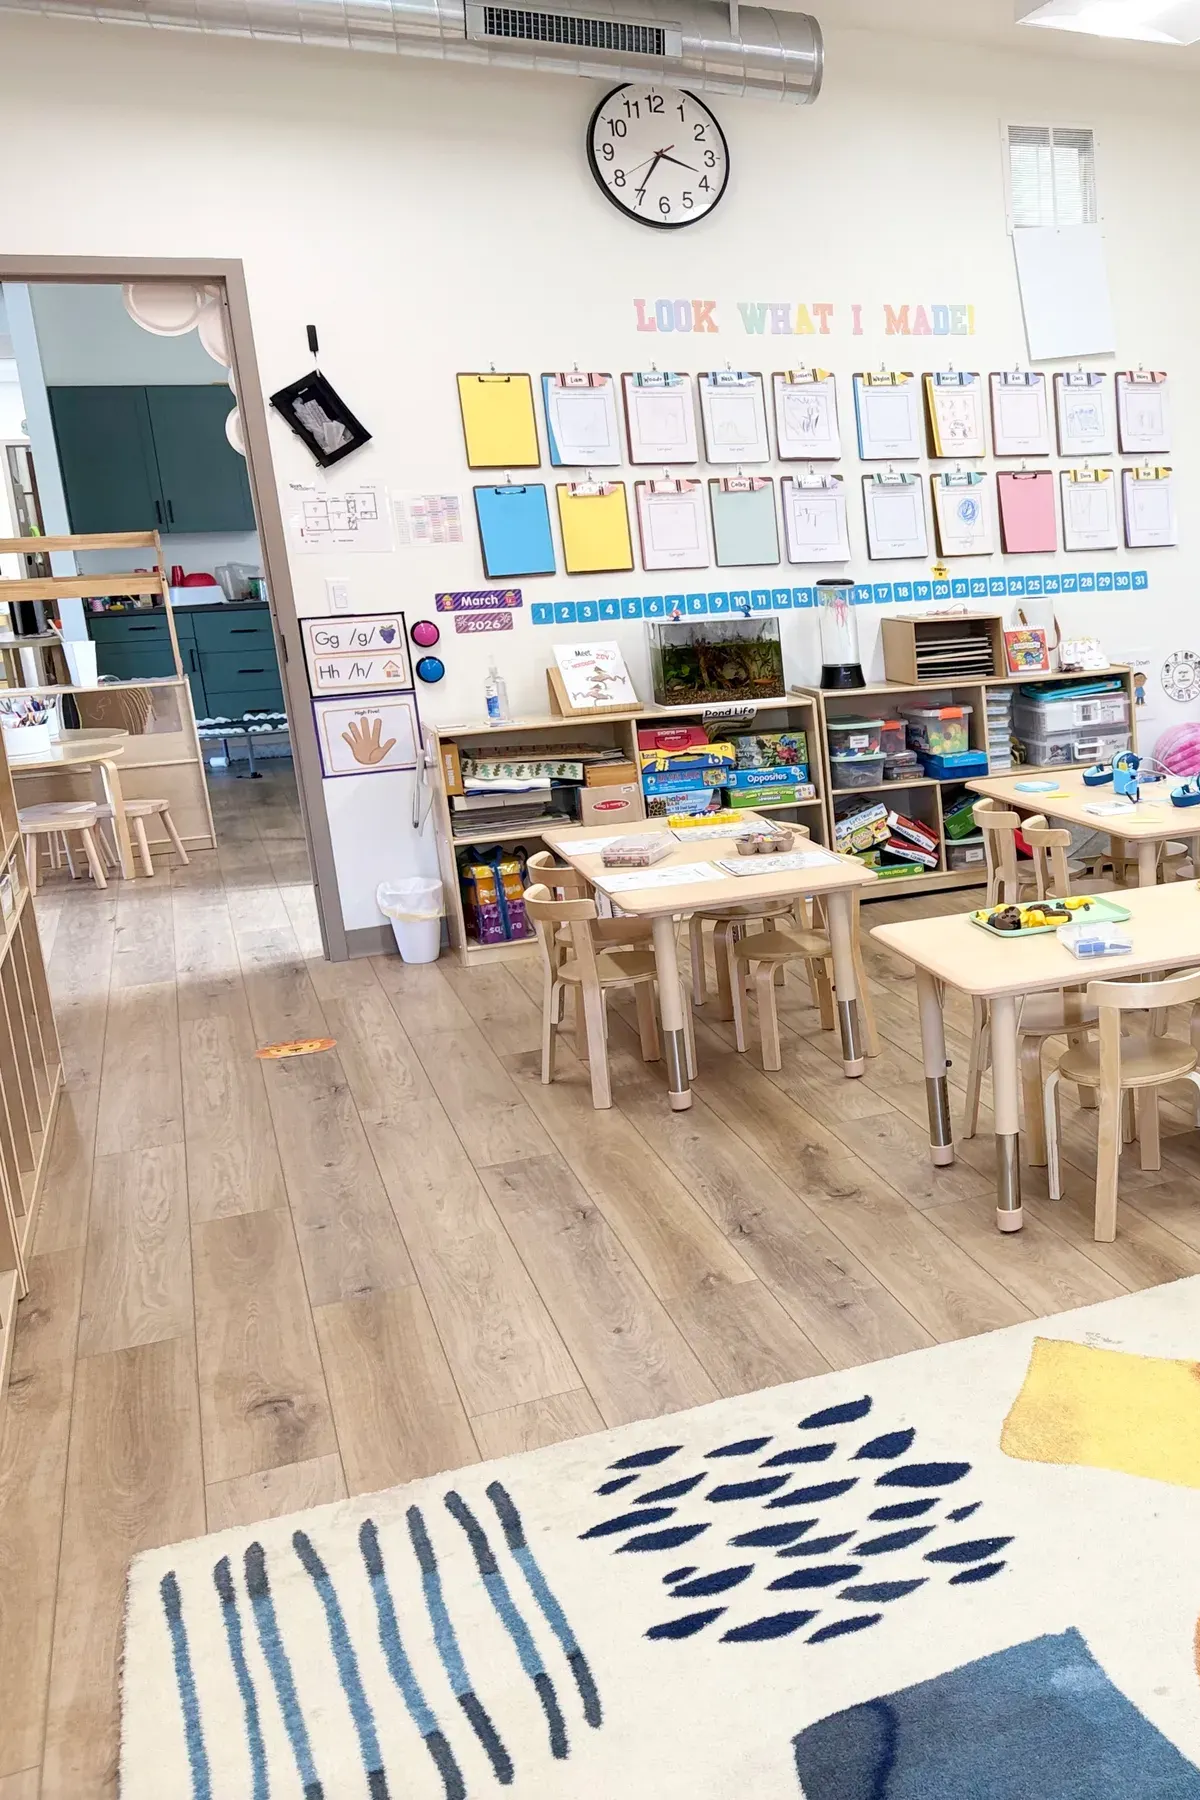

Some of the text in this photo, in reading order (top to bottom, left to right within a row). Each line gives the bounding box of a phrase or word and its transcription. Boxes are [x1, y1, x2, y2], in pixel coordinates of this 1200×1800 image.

[623, 100, 640, 118] 11
[645, 95, 665, 113] 12
[677, 104, 685, 122] 1
[607, 119, 627, 138] 10
[694, 124, 705, 141] 2
[602, 144, 614, 161] 9
[704, 150, 716, 167] 3
[614, 170, 626, 187] 8
[699, 176, 709, 192] 4
[635, 189, 646, 206] 7
[659, 197, 671, 213] 6
[682, 192, 694, 209] 5
[633, 299, 975, 336] LOOK WHAT I MADE!
[461, 595, 498, 606] March
[540, 609, 545, 618] 1
[562, 607, 569, 618] 2
[584, 607, 591, 617] 3
[606, 604, 613, 614] 4
[628, 603, 635, 613] 5
[650, 602, 657, 612] 6
[671, 601, 679, 611] 7
[693, 599, 700, 610] 8
[715, 598, 722, 608] 9
[734, 596, 746, 606] 10
[757, 595, 766, 605] 11
[777, 594, 787, 604] 12
[797, 593, 808, 603] 13
[858, 589, 869, 599] 16
[878, 589, 888, 598] 17
[898, 587, 909, 597] 18
[917, 586, 927, 596] 19
[936, 585, 948, 595] 20
[955, 583, 965, 593] 21
[973, 581, 985, 592] 22
[991, 581, 1004, 592] 23
[1011, 580, 1022, 591] 24
[1028, 580, 1040, 590] 25
[1046, 579, 1058, 589] 26
[1064, 578, 1075, 588] 27
[1081, 577, 1092, 587] 28
[1099, 576, 1110, 587] 29
[1116, 575, 1128, 586] 30
[1135, 575, 1145, 585] 31
[468, 620, 500, 631] 2026
[315, 627, 375, 648] Gg /g/
[320, 662, 372, 679] Hh /h/
[705, 709, 732, 718] Pond
[748, 774, 787, 783] Opposites
